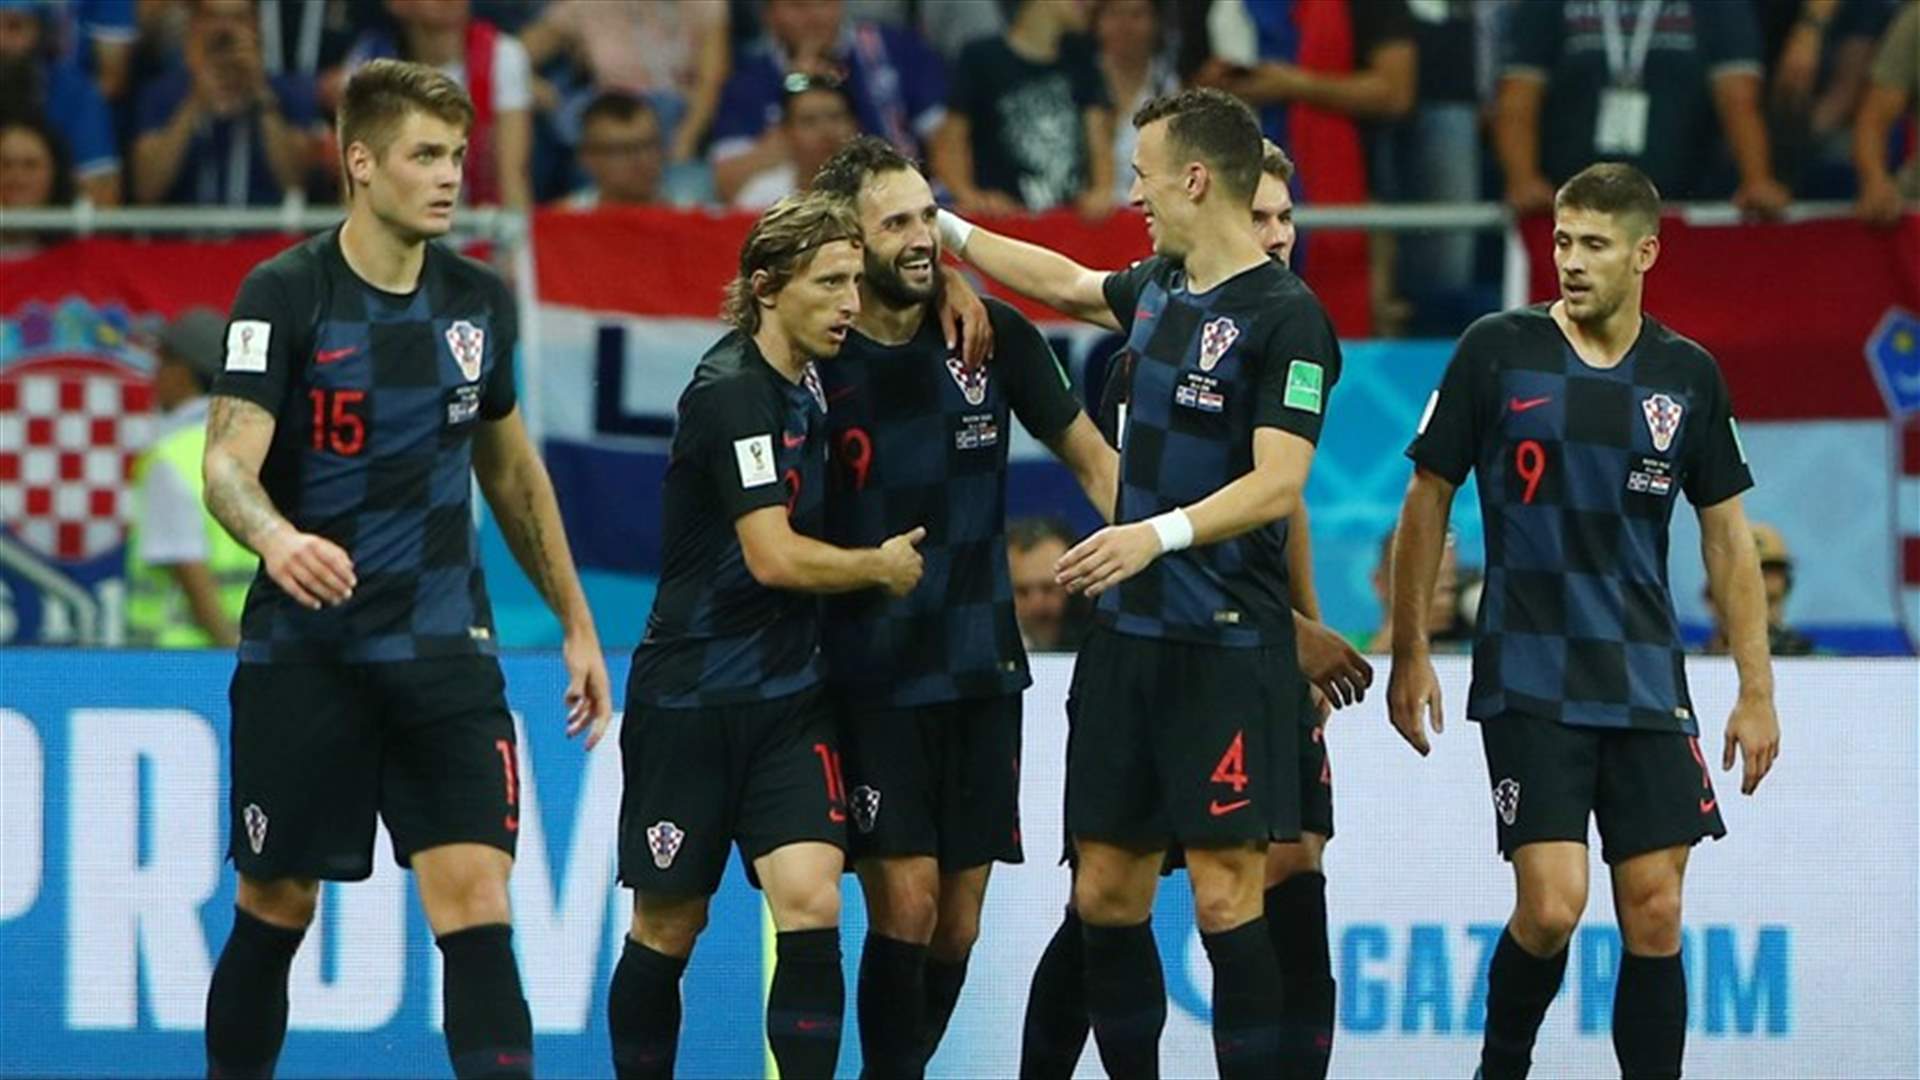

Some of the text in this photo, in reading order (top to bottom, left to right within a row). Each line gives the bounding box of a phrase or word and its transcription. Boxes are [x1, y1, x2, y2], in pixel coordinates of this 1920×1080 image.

[309, 389, 366, 456] 15
[1515, 438, 1545, 505] 9
[1211, 729, 1249, 793] 4
[1339, 924, 1788, 1034] GAZRM
